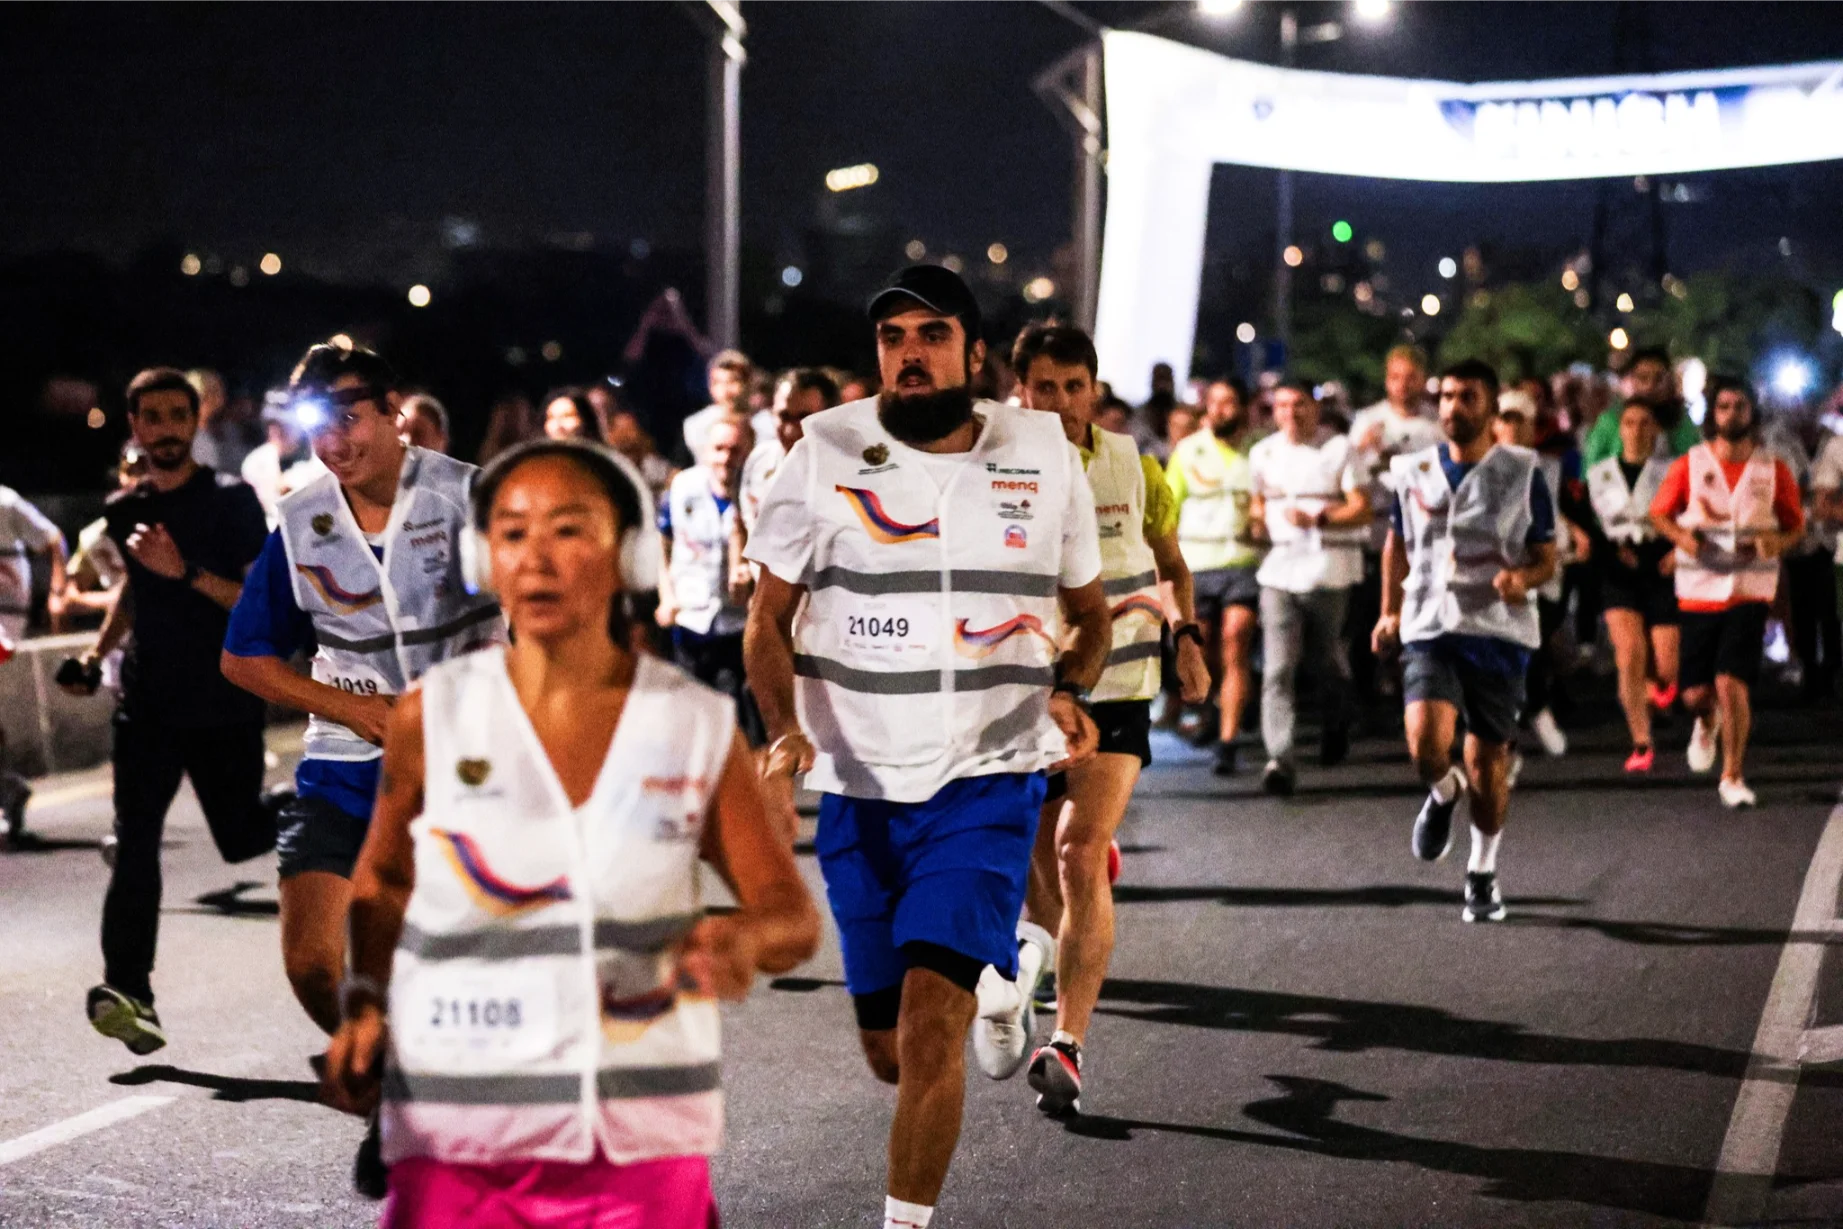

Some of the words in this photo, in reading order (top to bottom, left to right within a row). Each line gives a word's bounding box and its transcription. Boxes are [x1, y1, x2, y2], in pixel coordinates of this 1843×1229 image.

[991, 480, 1038, 494] menq
[848, 615, 909, 637] 21049
[327, 673, 377, 694] 1019
[430, 996, 522, 1028] 21108
